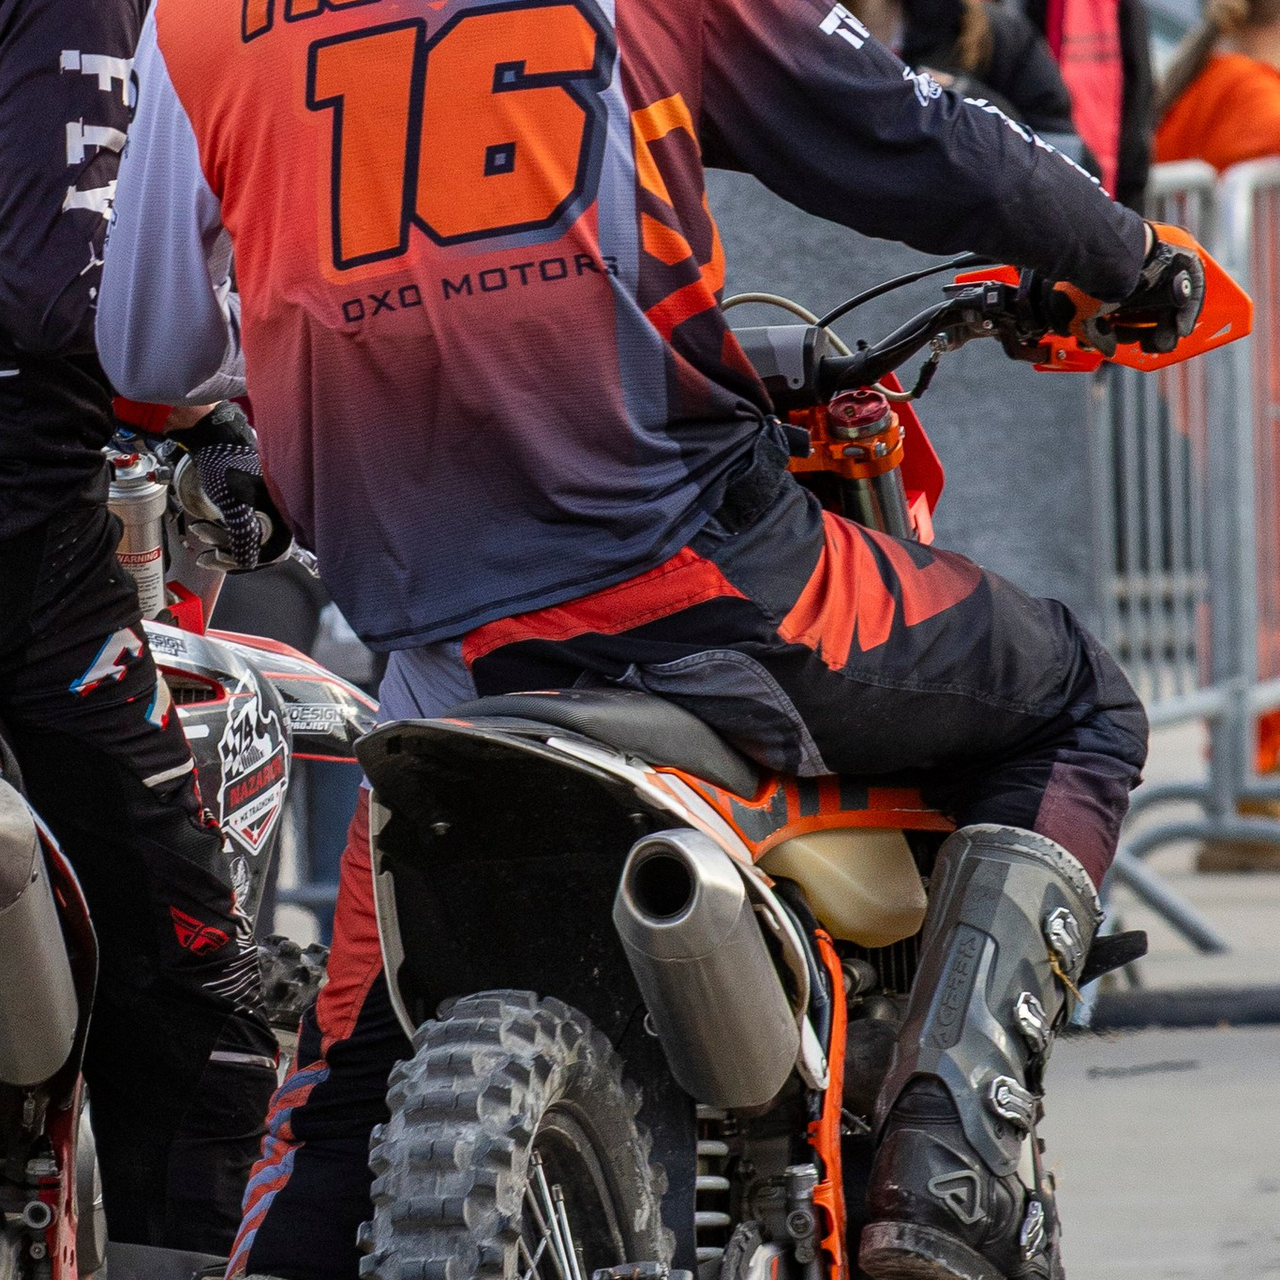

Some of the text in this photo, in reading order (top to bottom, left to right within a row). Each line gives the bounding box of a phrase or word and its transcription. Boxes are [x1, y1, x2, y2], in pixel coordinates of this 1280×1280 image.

[308, 0, 606, 267] 16
[342, 254, 619, 323] OXO MOTORS
